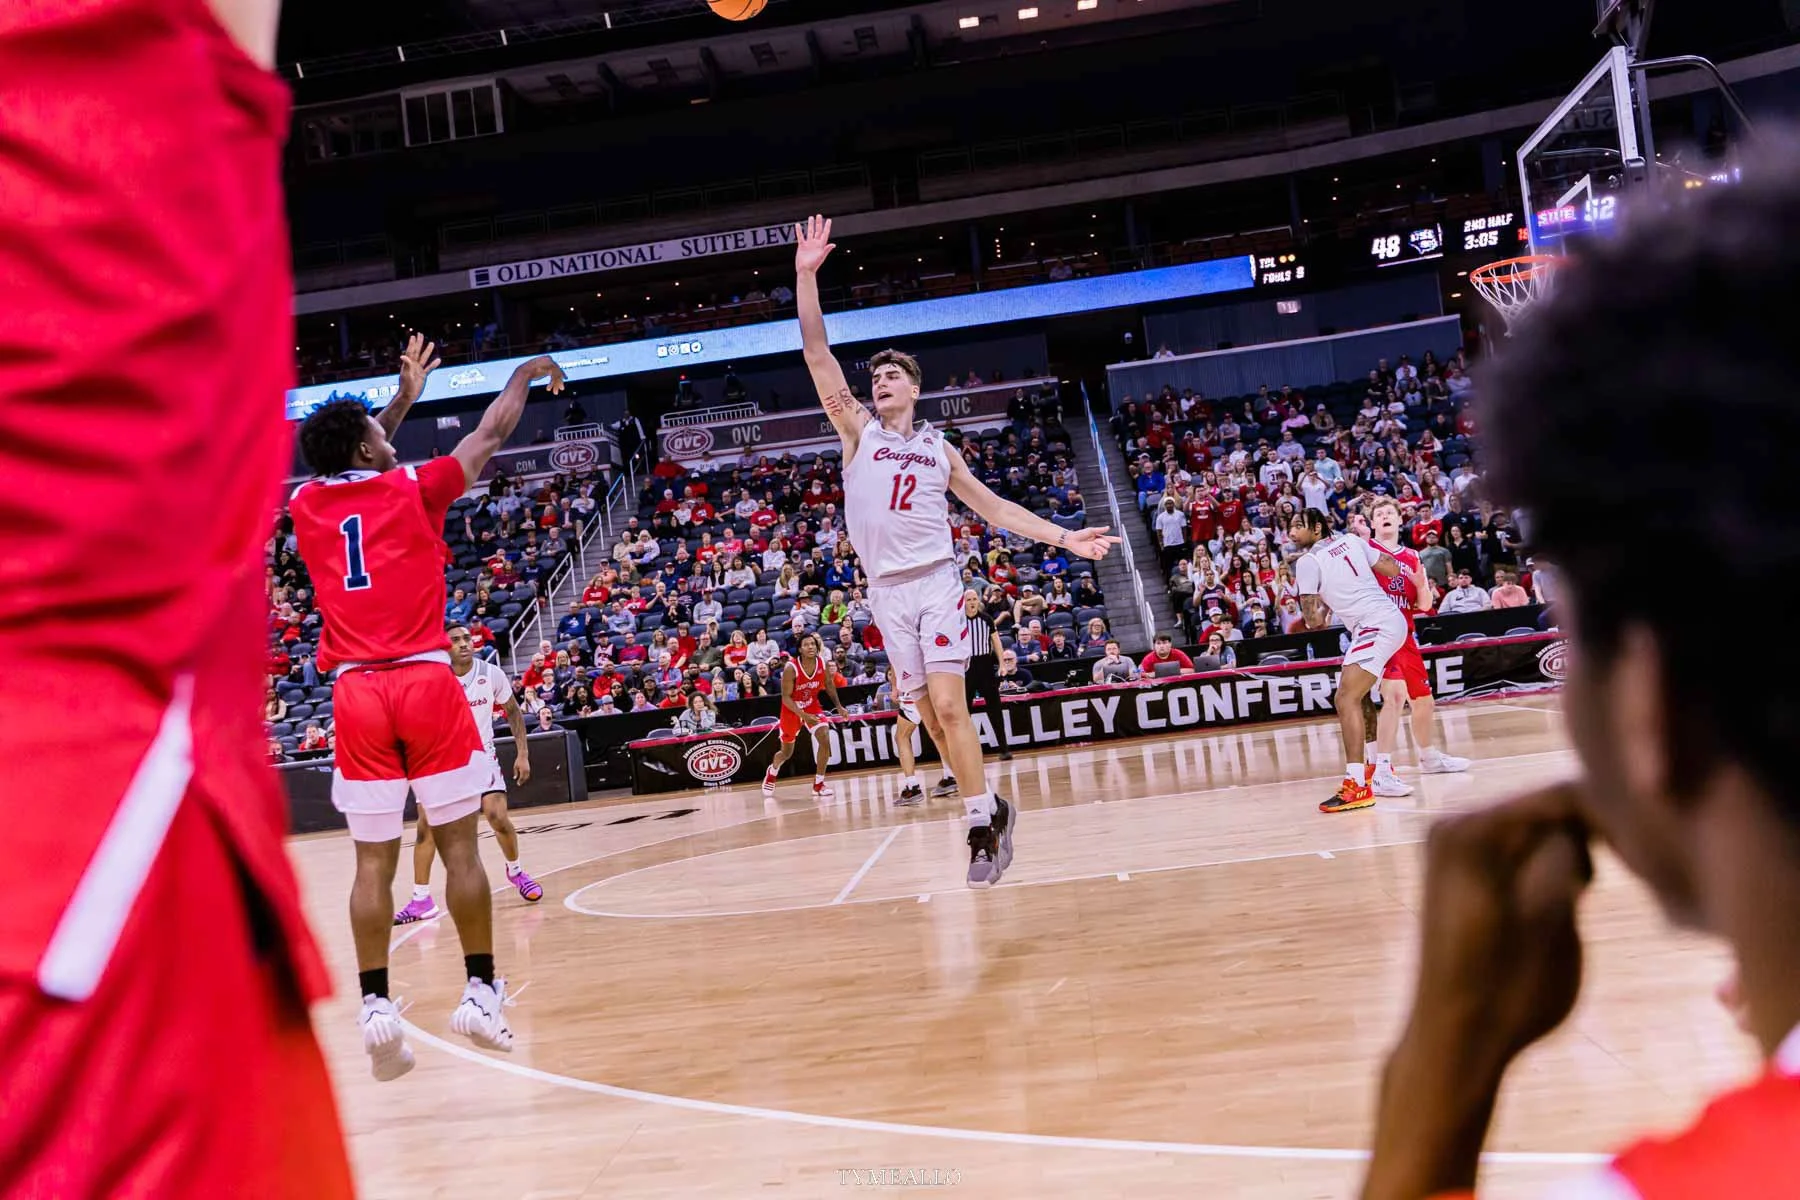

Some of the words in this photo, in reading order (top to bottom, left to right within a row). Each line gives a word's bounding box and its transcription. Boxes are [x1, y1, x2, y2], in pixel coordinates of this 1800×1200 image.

[1463, 219, 1486, 232] 2ND
[1487, 213, 1513, 229] HALF
[1371, 235, 1400, 259] 48
[1464, 230, 1499, 250] 3:05
[498, 262, 544, 283] OLD
[550, 246, 662, 275] NATIONAL
[681, 231, 747, 257] SUITE
[1263, 270, 1292, 284] FOULS
[940, 396, 971, 417] OVC
[732, 424, 762, 443] OVC
[818, 421, 836, 435] .CO
[673, 436, 701, 450] OVC
[515, 460, 537, 473] .COM
[560, 449, 588, 464] OVC
[873, 447, 937, 470] Cougars
[889, 474, 917, 511] 12
[339, 513, 372, 591] 1
[1344, 555, 1359, 577] 1
[1389, 576, 1405, 592] 32
[969, 696, 1121, 748] ALLEY
[1136, 656, 1465, 729] CONFERE
[699, 755, 729, 772] OVC
